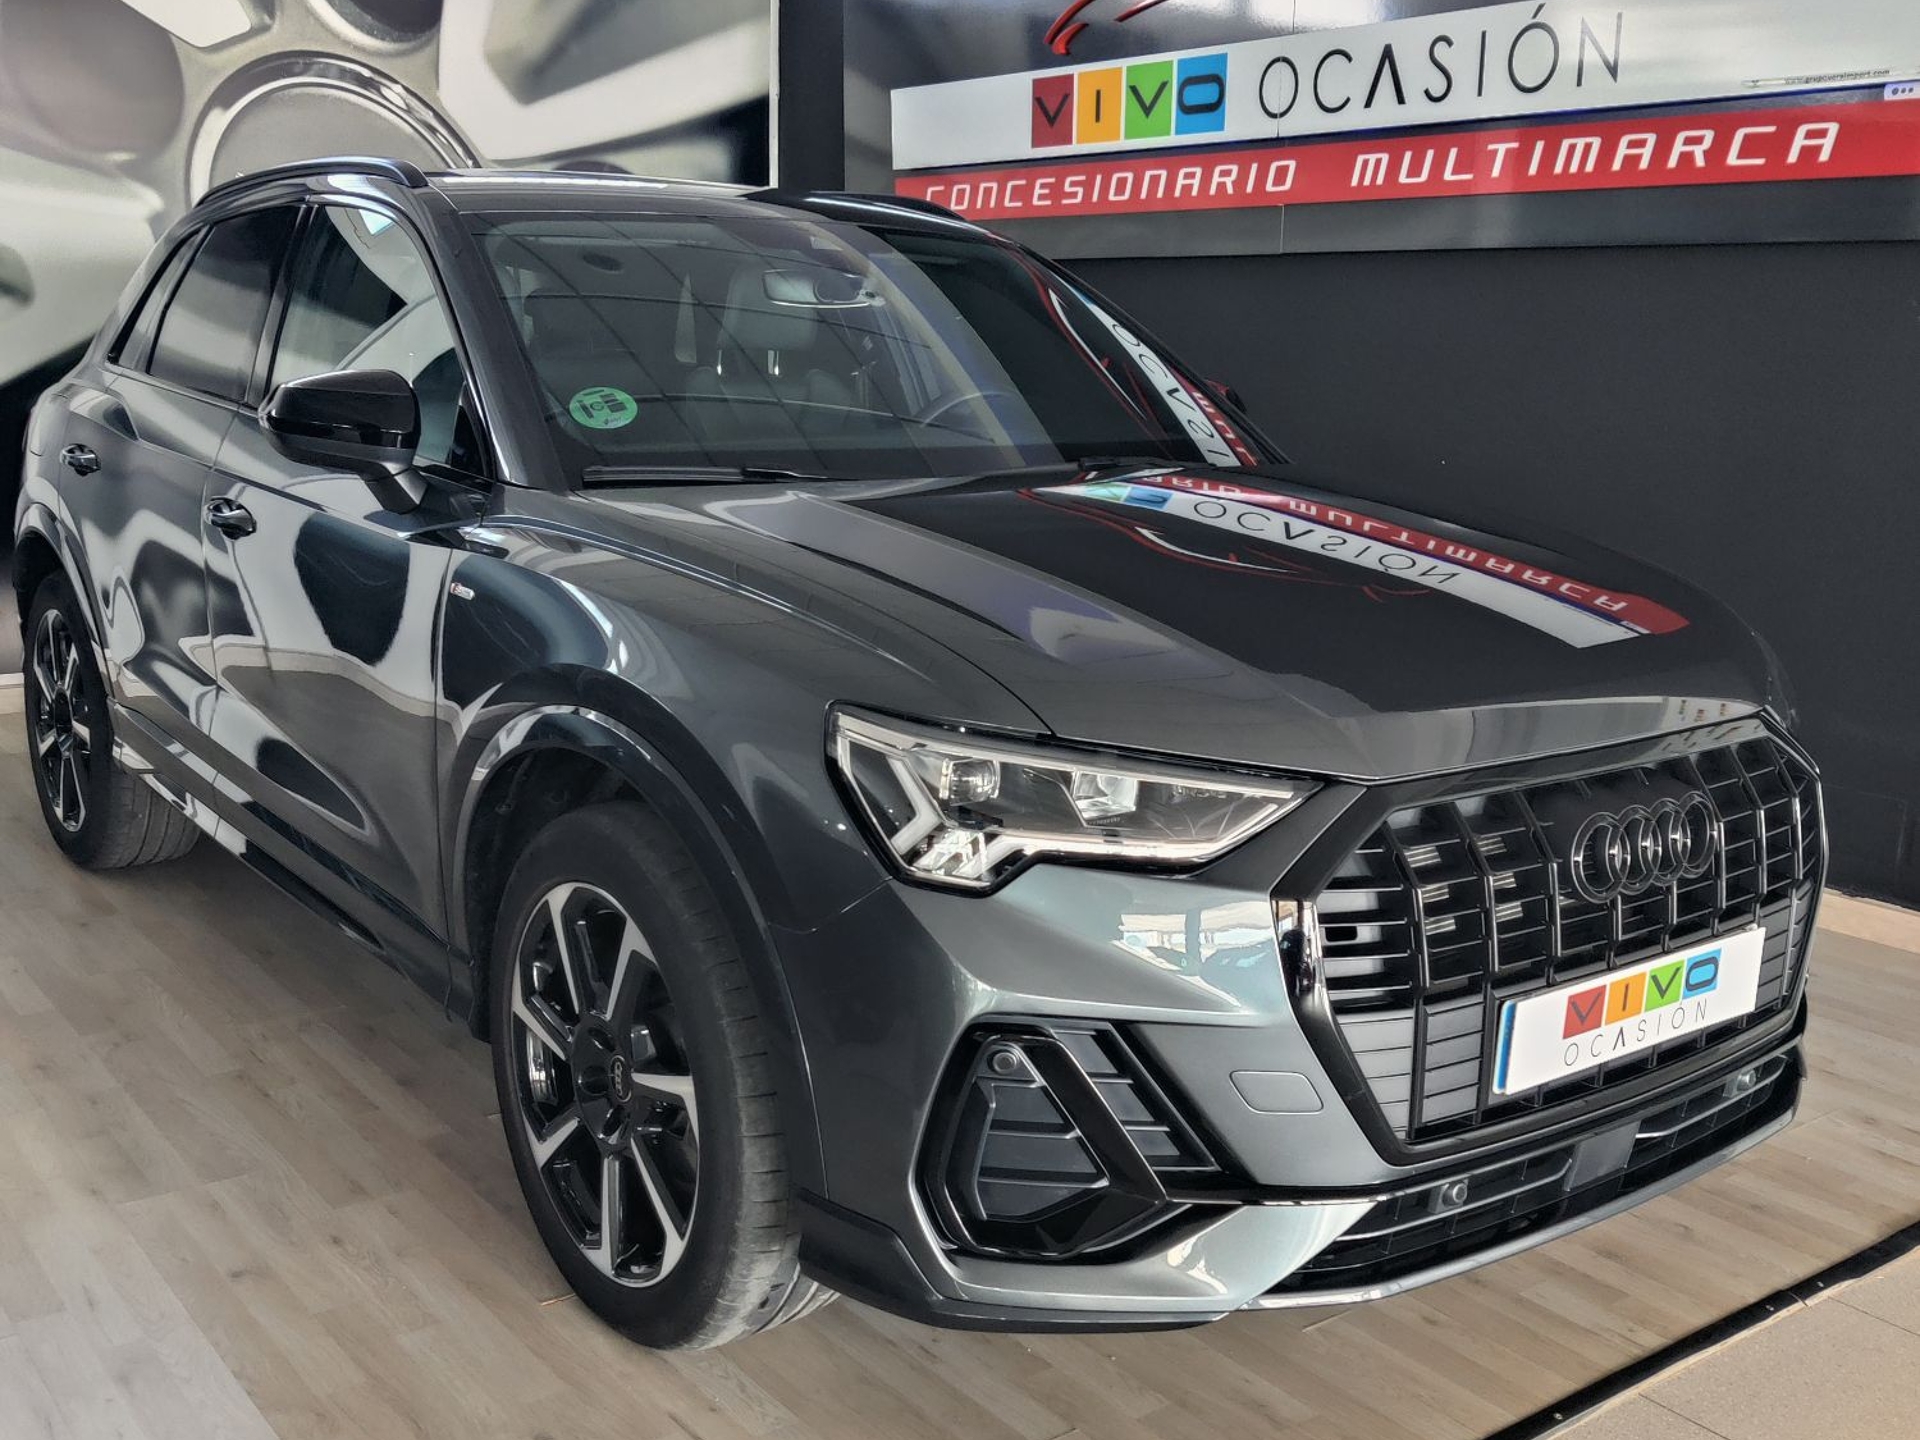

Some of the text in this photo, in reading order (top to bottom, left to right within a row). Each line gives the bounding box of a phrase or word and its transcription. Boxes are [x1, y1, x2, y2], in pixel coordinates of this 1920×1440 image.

[1034, 3, 1624, 128] VIVO OCASIÓN
[925, 121, 1841, 211] CONCESIONARIO MULTIMARCA
[1570, 955, 1720, 1026] VIVO
[1563, 1000, 1708, 1067] OCASIÓN
